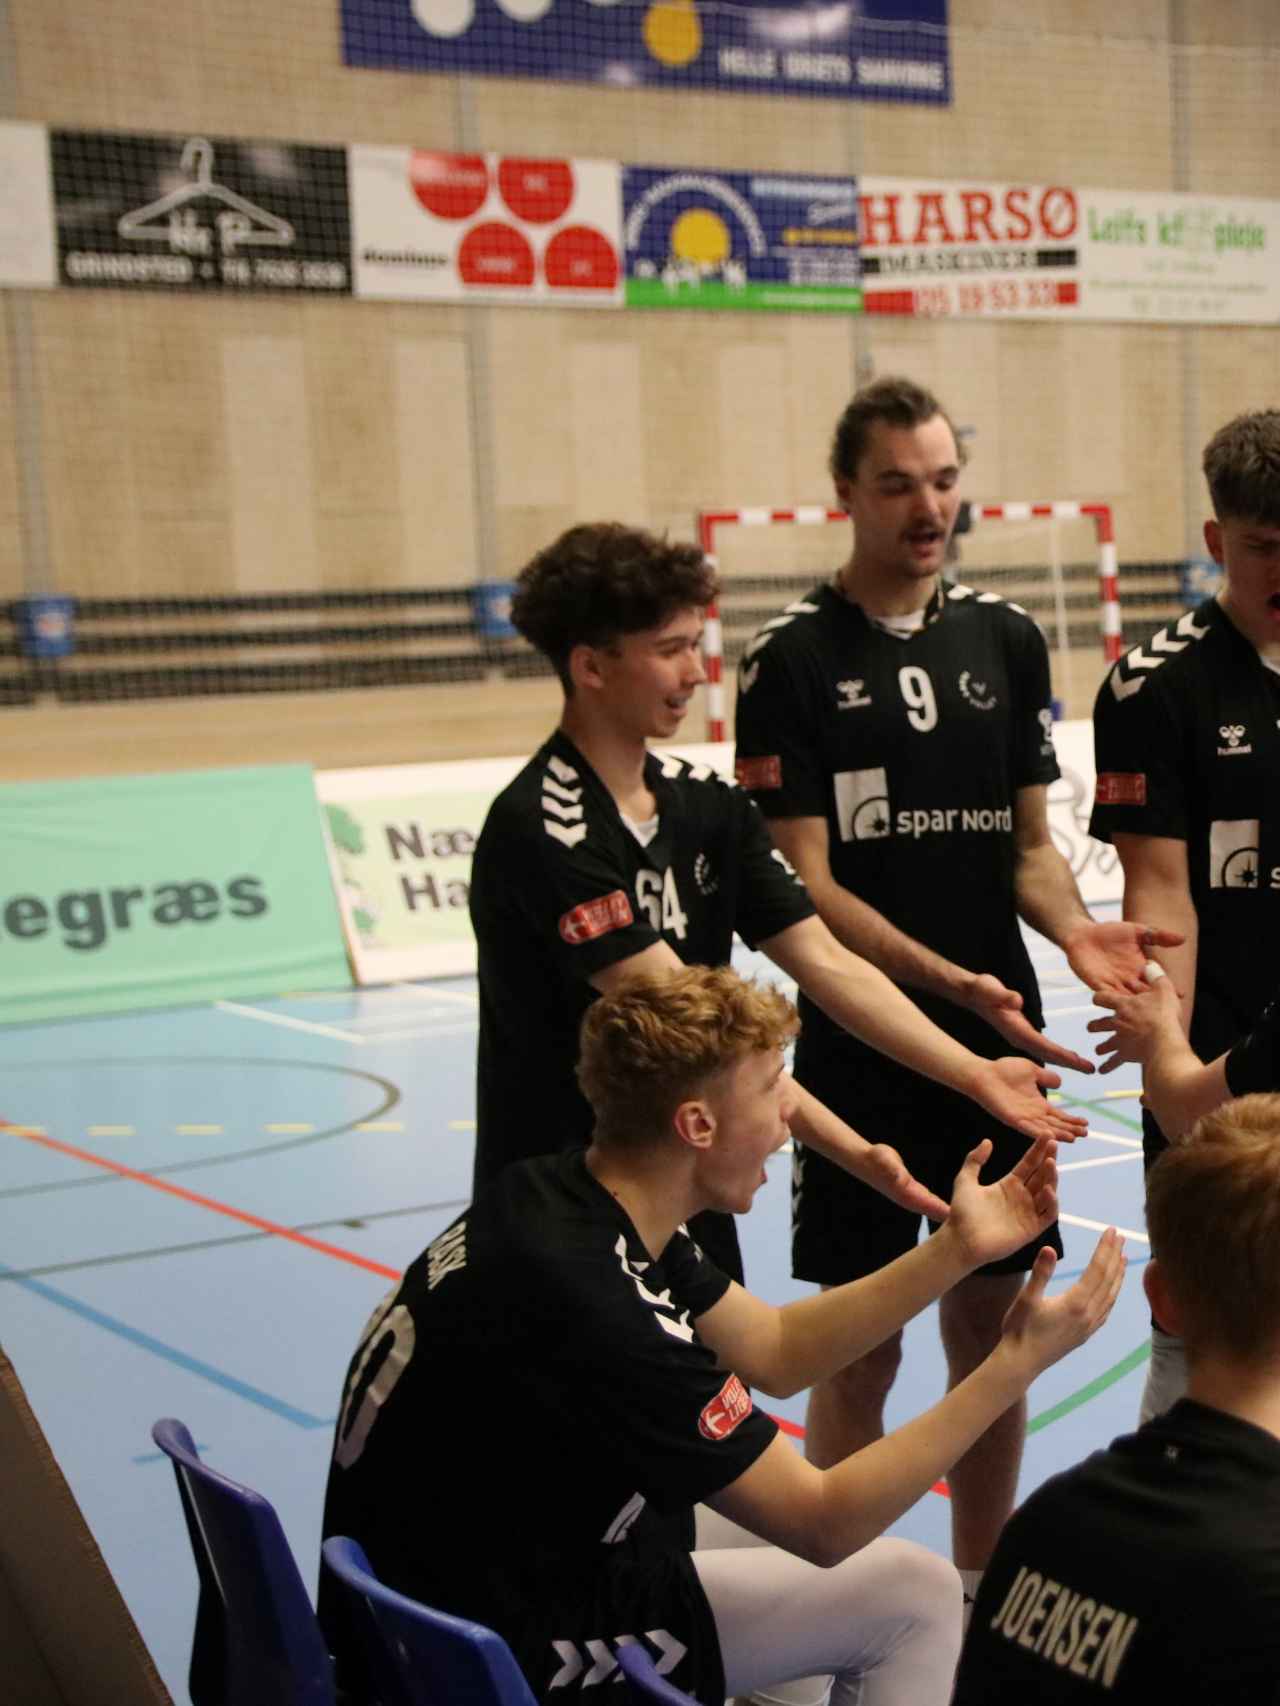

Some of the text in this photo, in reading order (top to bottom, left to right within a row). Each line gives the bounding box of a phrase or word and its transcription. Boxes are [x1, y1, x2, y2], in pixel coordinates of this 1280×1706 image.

[861, 187, 1078, 246] HARSØ
[899, 666, 938, 732] 9
[896, 810, 955, 838] spar
[635, 866, 688, 939] 64
[990, 1566, 1139, 1689] JOENSEN
